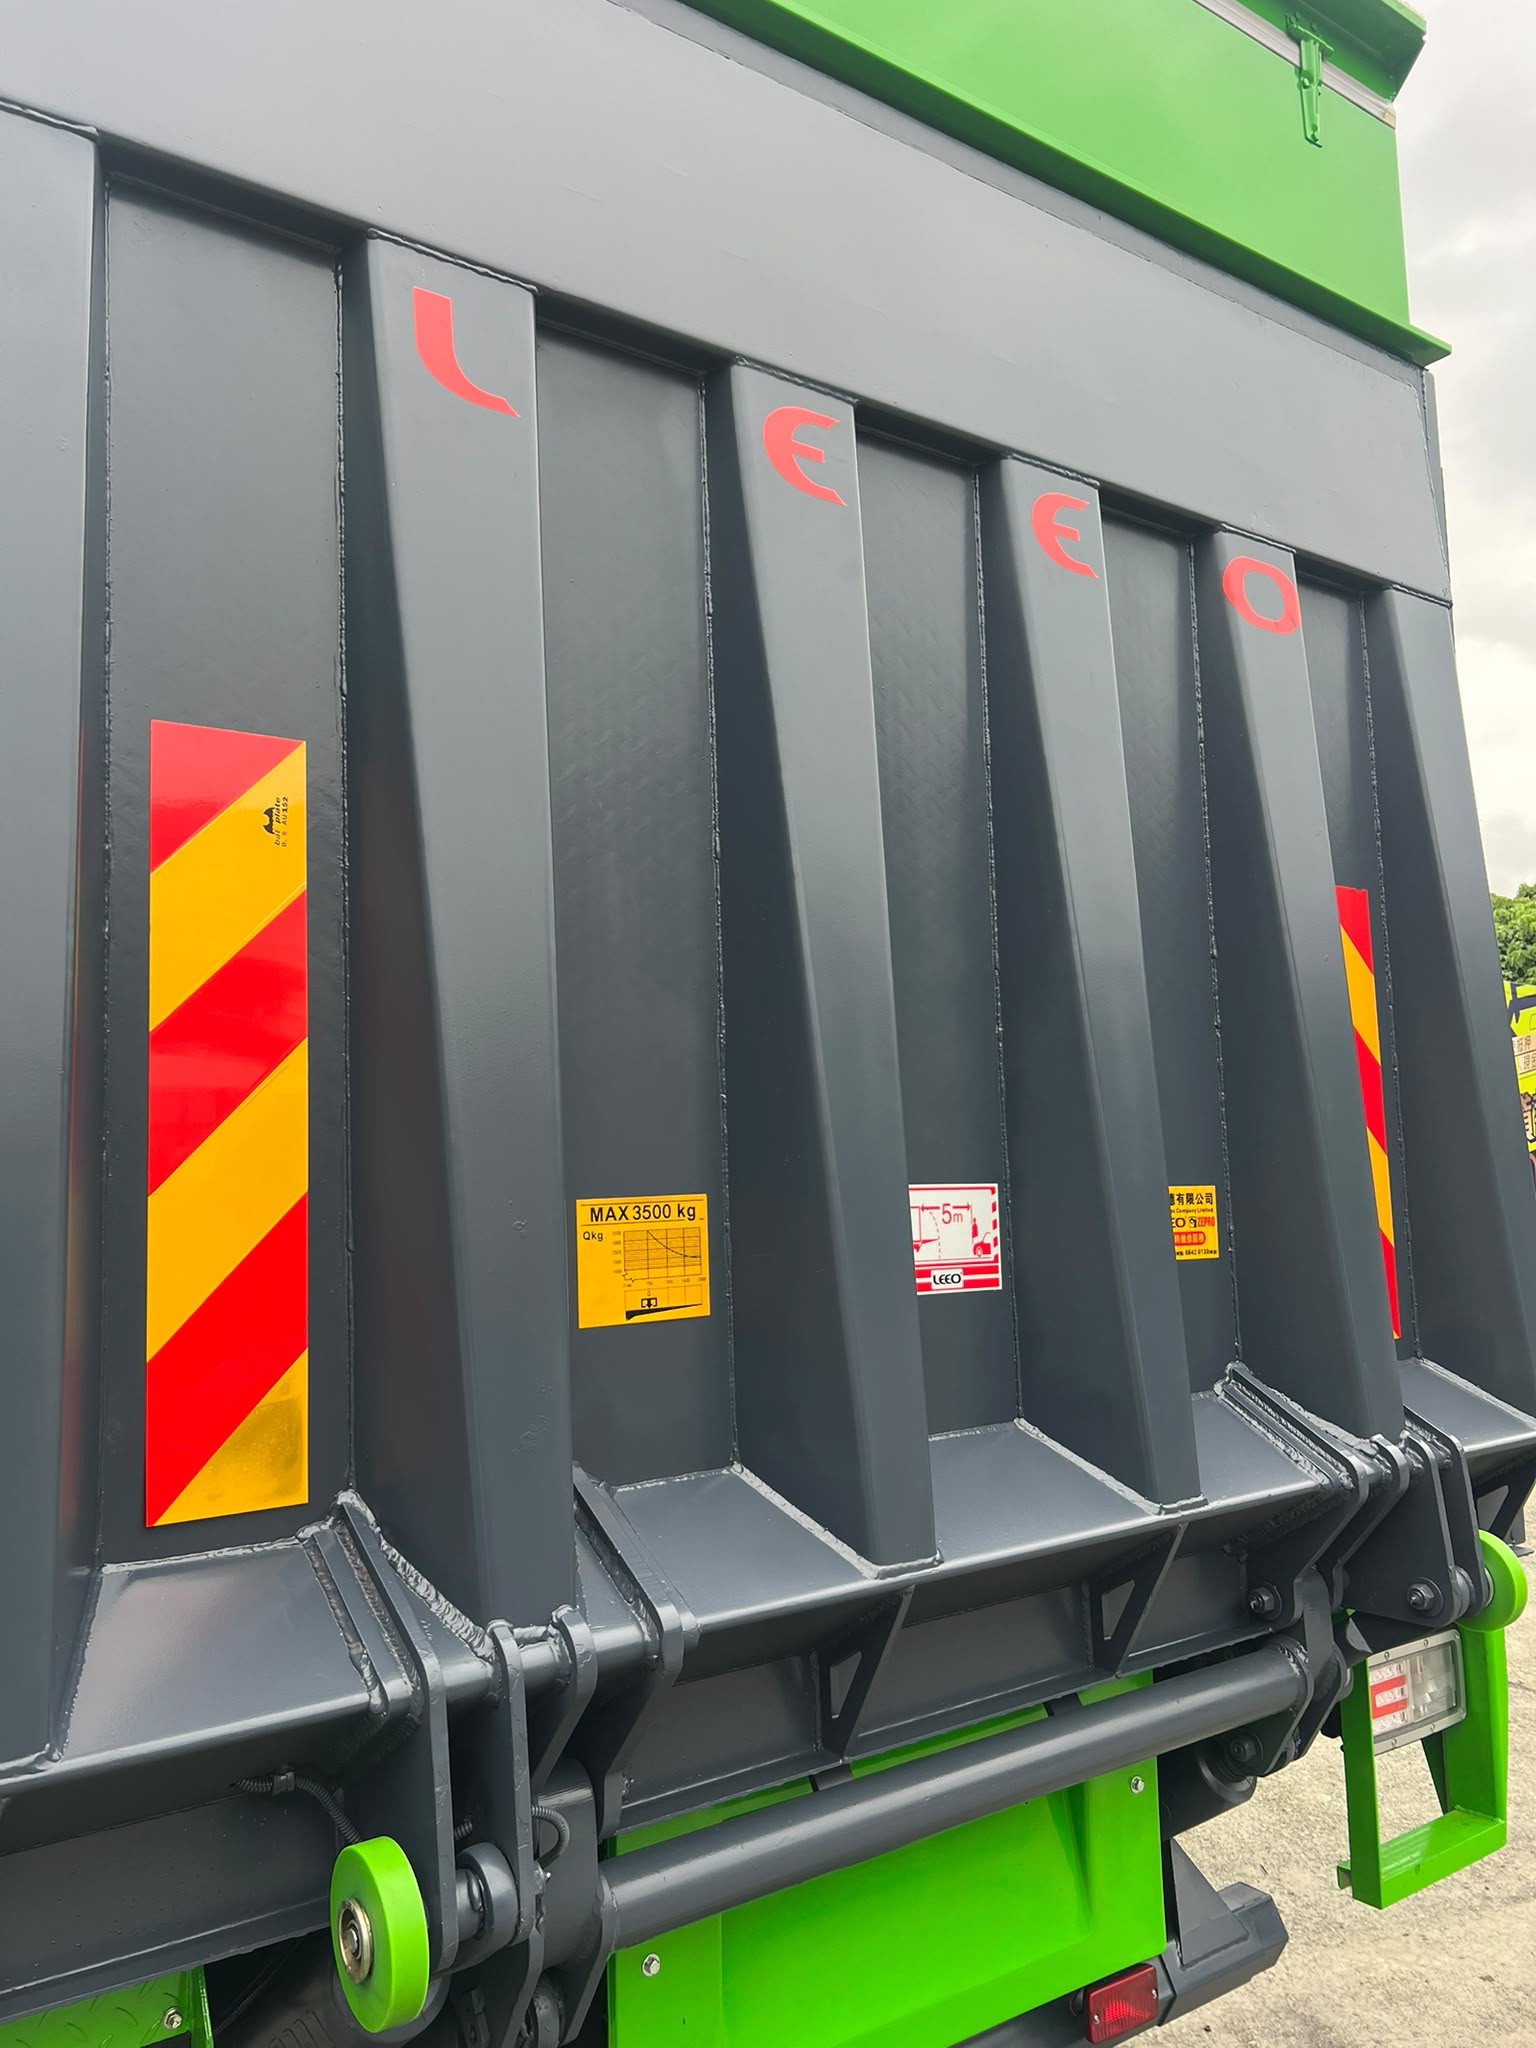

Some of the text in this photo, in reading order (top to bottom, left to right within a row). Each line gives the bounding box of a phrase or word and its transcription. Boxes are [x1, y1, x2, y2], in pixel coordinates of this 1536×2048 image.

[412, 287, 518, 417] L
[590, 1203, 696, 1222] MAX 3500 kg
[582, 1231, 604, 1241] Qkg
[933, 1273, 962, 1285] LEEO
